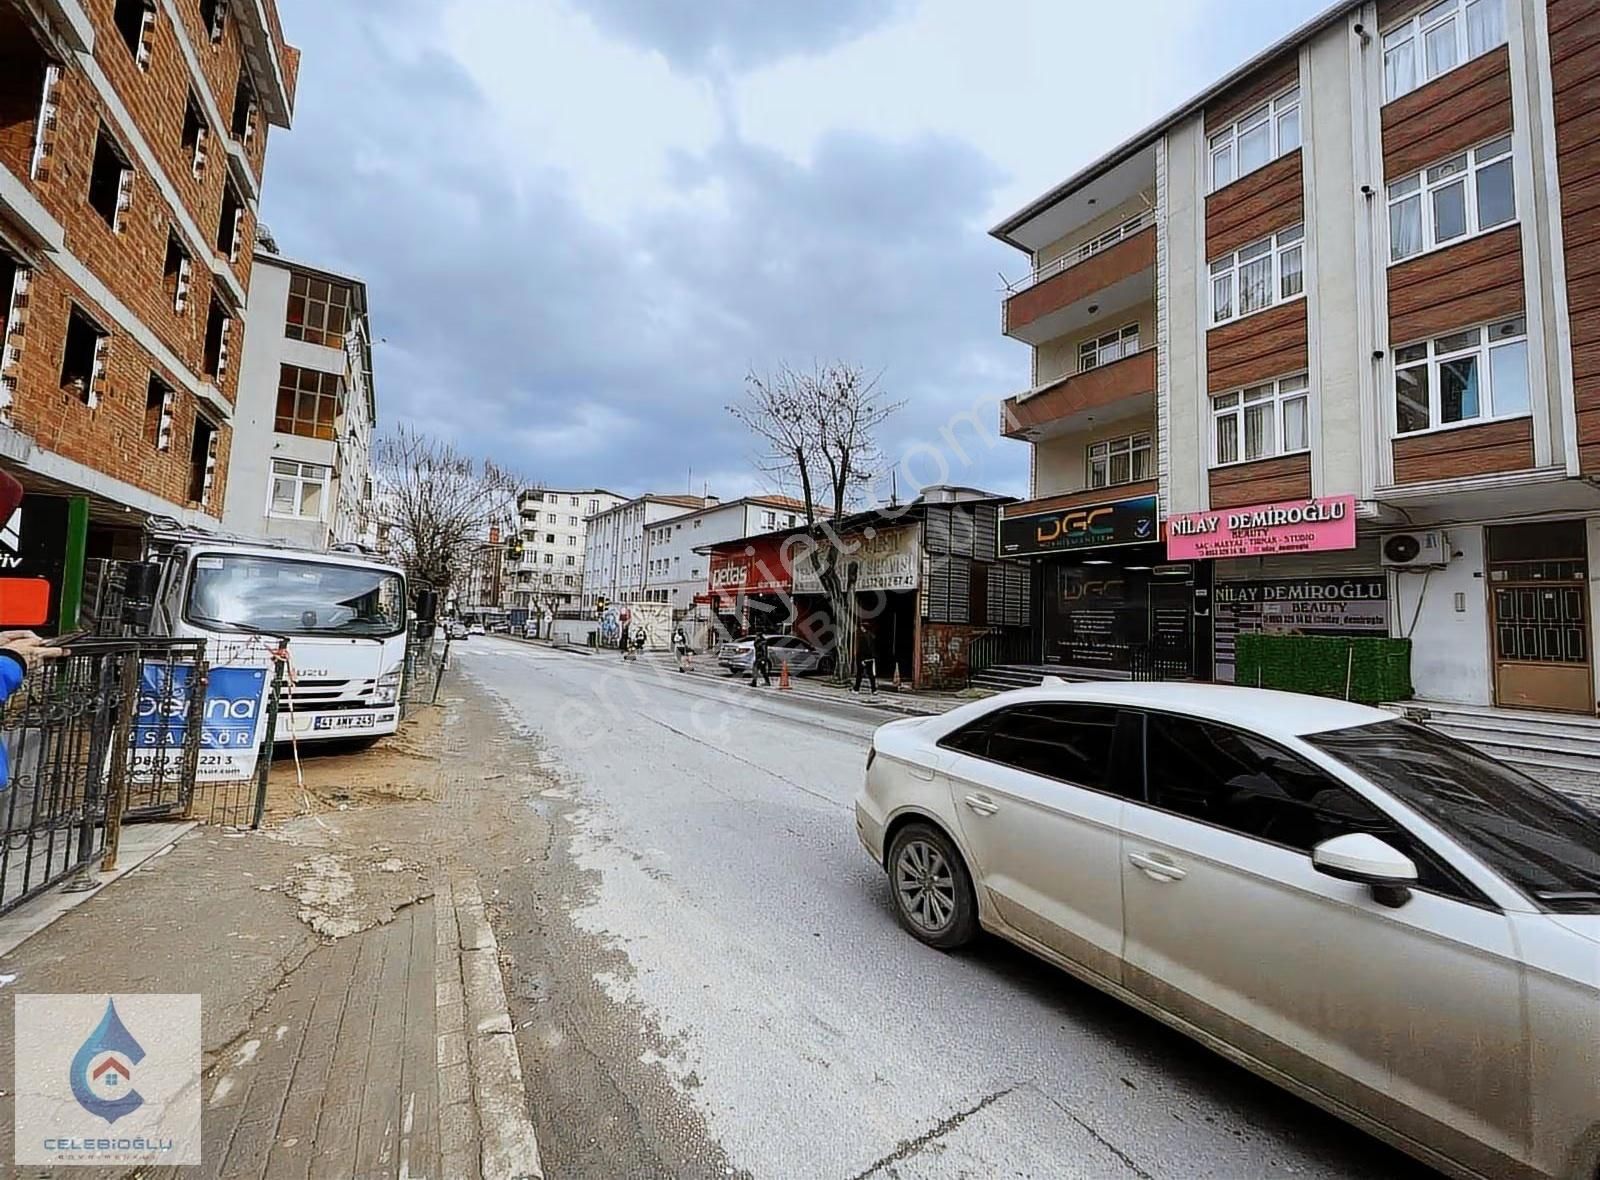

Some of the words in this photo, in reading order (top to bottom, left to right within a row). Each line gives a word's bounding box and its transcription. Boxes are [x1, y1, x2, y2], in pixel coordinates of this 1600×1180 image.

[1037, 507, 1114, 542] DGC
[1171, 514, 1220, 536] NİLAY
[1227, 498, 1346, 530] DEMİROĞLU
[1231, 528, 1269, 539] BEAUTY
[1215, 585, 1258, 603] NİLAY
[1263, 580, 1383, 600] DEMİROĞLU
[1292, 602, 1347, 613] BEAUTY
